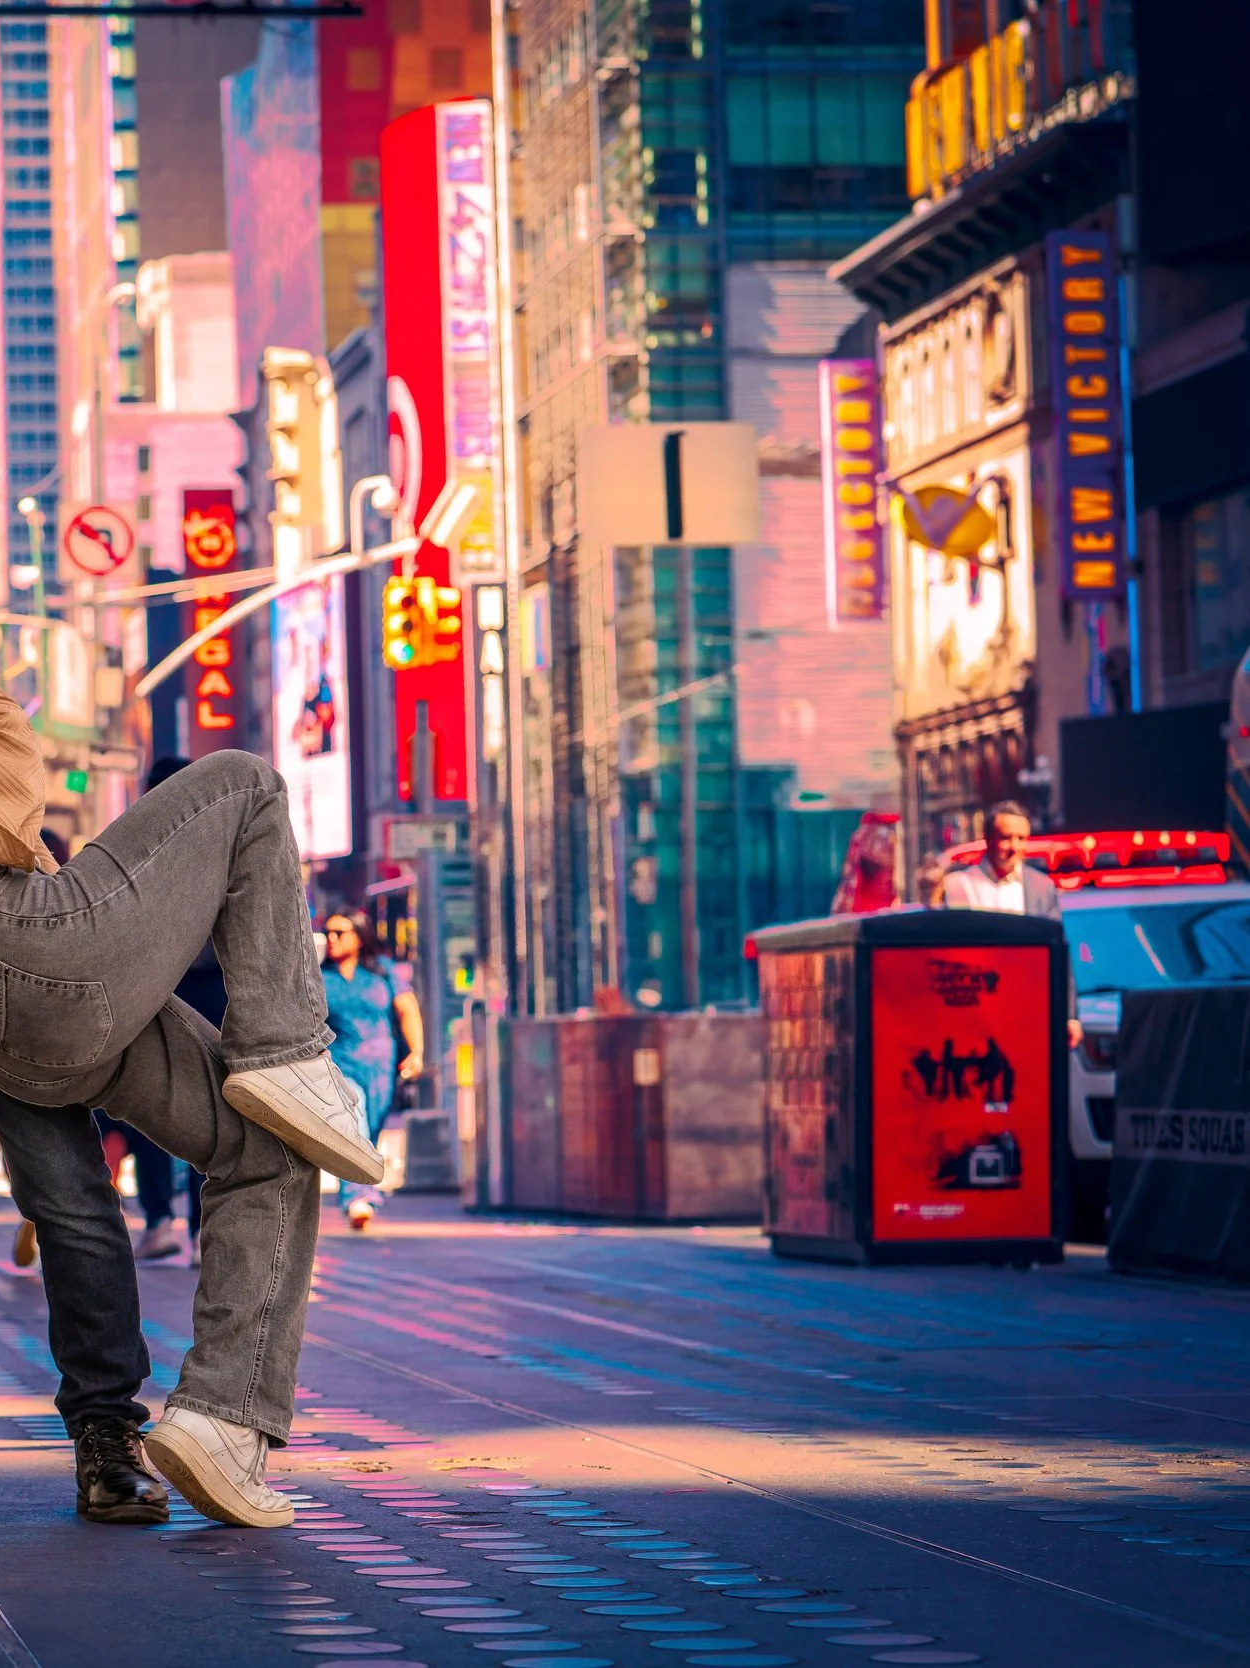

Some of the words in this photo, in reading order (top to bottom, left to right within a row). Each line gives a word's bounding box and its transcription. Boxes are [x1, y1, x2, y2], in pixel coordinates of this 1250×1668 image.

[1060, 244, 1111, 457] VICTORY
[1070, 487, 1116, 589] NEW
[1130, 1113, 1184, 1150] TIES
